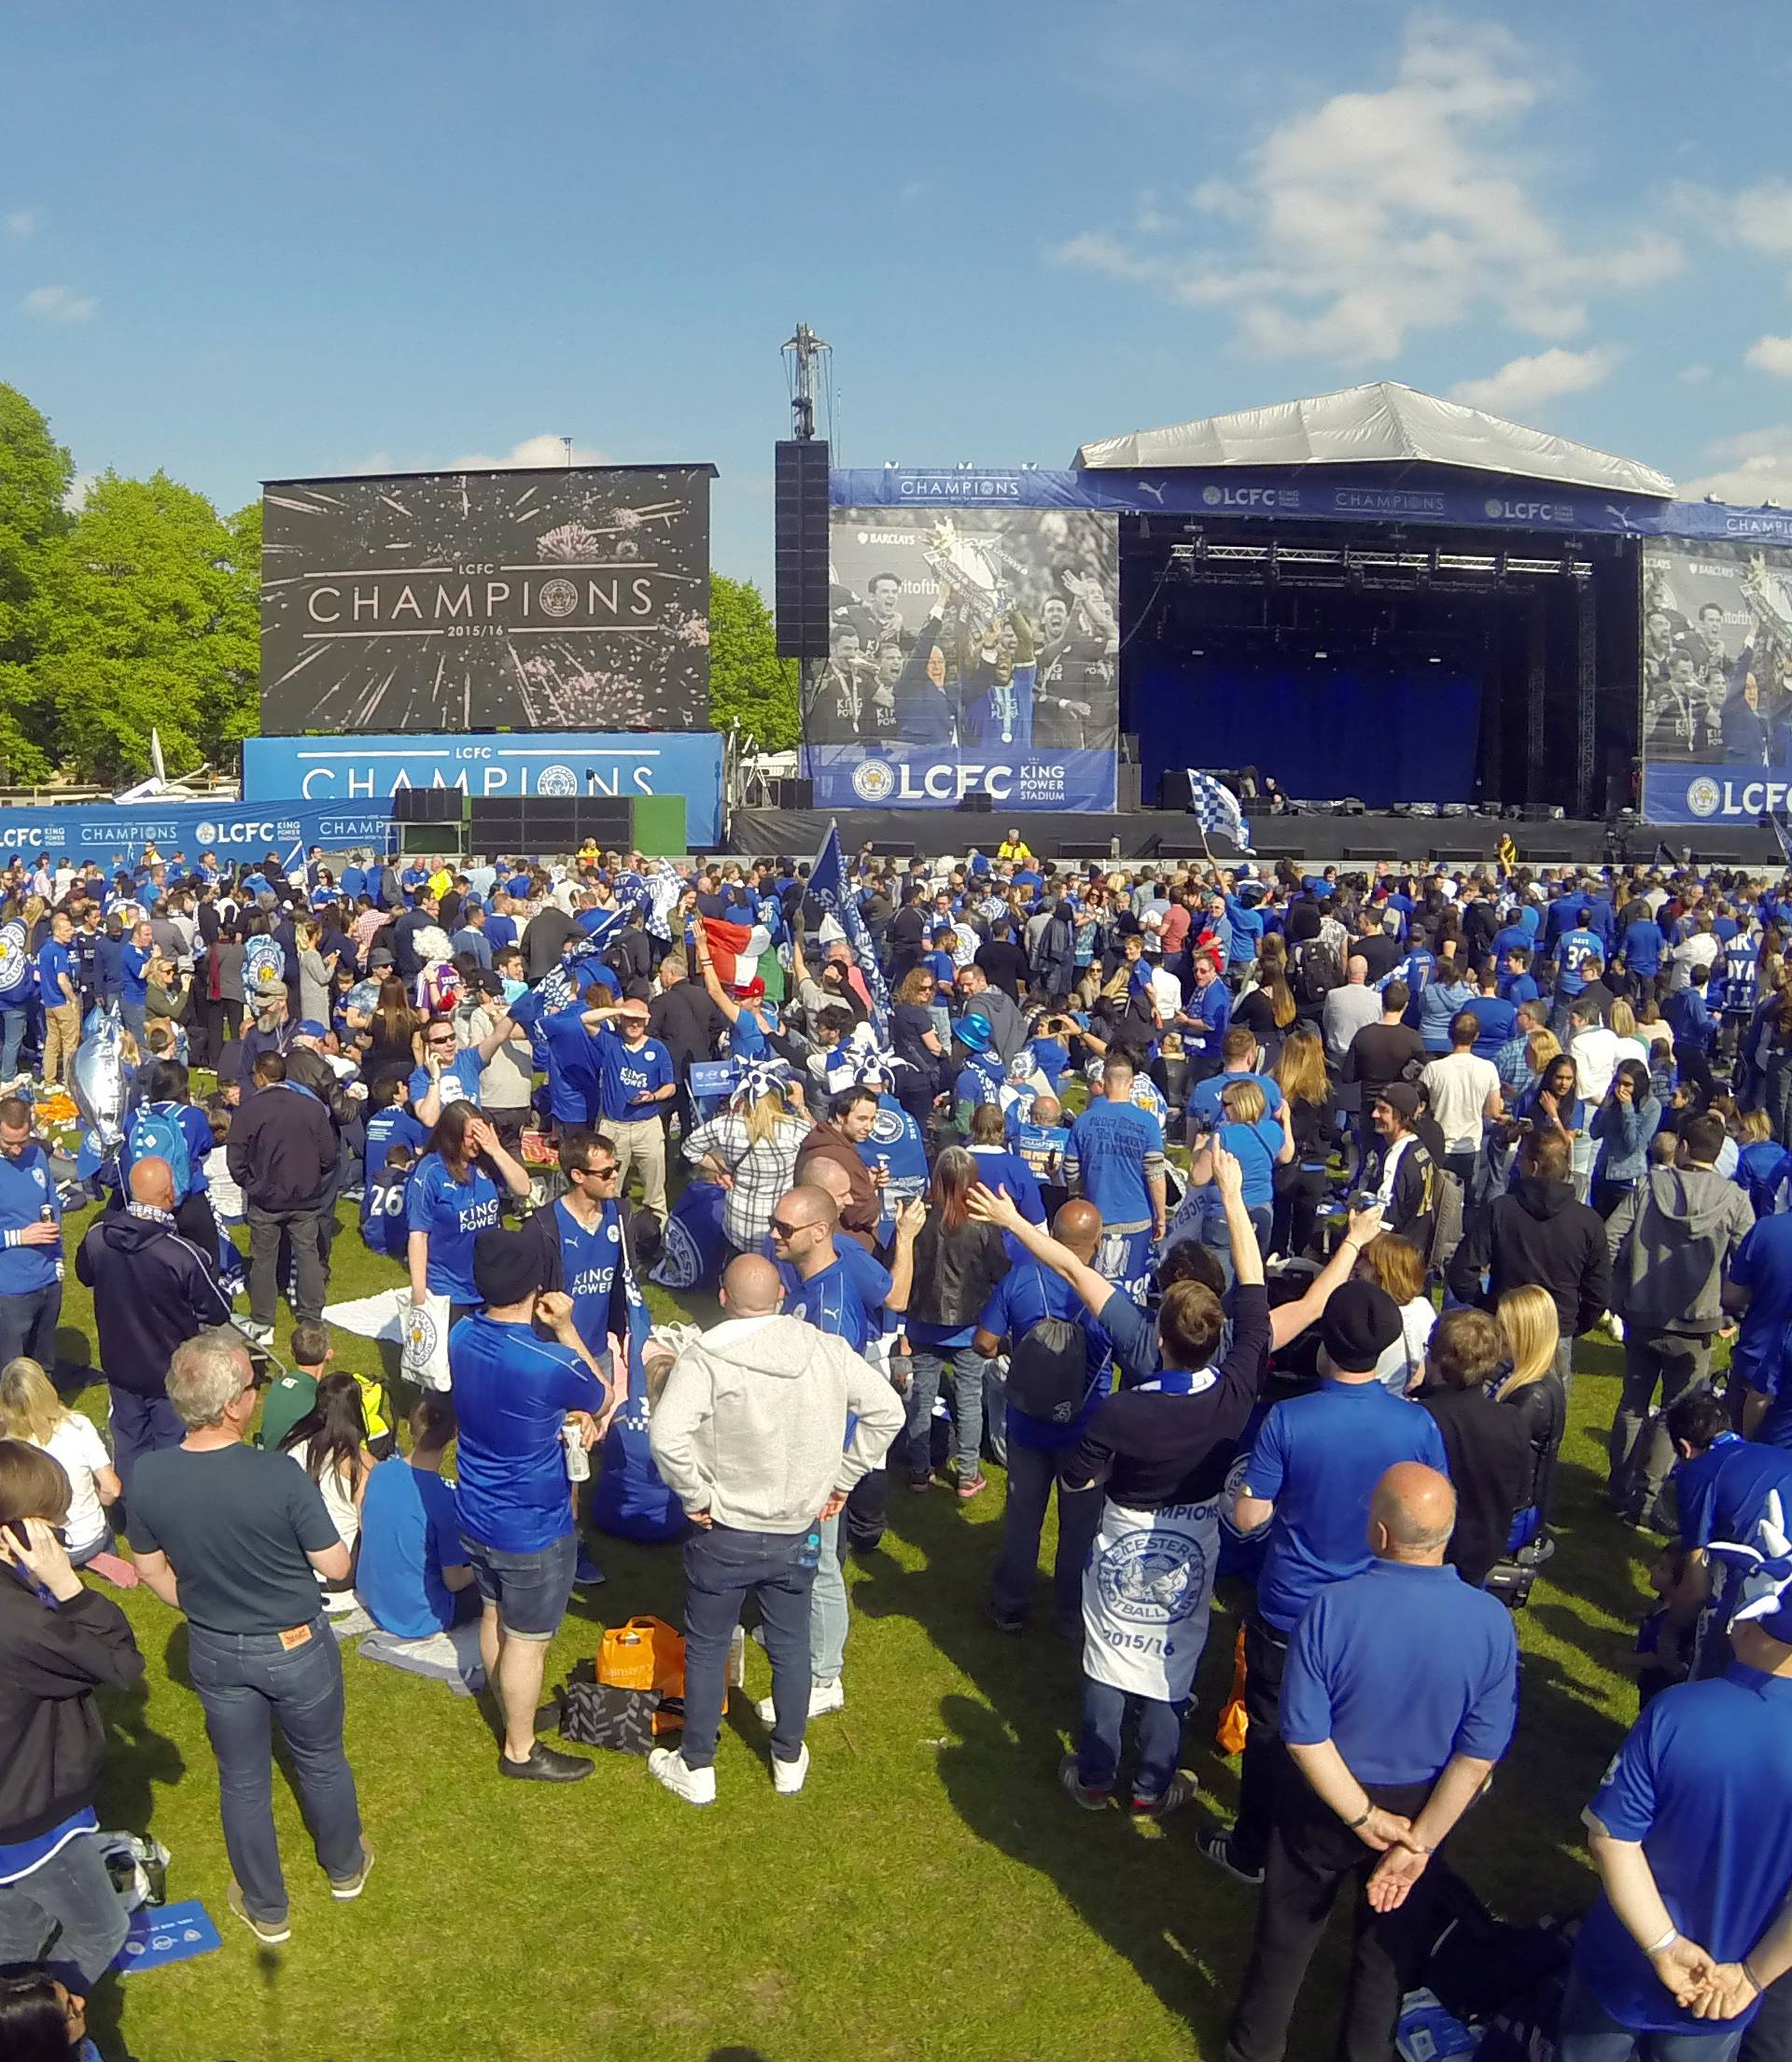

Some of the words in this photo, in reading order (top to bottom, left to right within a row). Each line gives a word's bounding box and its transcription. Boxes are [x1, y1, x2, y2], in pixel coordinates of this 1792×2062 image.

[901, 480, 1019, 496] CHAMPIONS
[1224, 487, 1276, 506] LCFC
[1336, 492, 1444, 511] CHAMPIONS
[1505, 501, 1552, 521] LCFC
[870, 534, 916, 545] BARCLAYS
[458, 563, 495, 575] LCFC
[1699, 564, 1734, 578] BARCLAYS
[308, 578, 653, 624] CHAMPIONS
[448, 624, 504, 638] 2015/16
[455, 747, 492, 760] LCFC
[1020, 765, 1065, 779] KING
[897, 764, 1013, 801] LCFC
[1020, 780, 1065, 791] POWER
[1020, 791, 1066, 801] STADIUM
[81, 826, 177, 841] CHAMPIONS
[217, 822, 274, 843] LCFC
[620, 1066, 648, 1078] KING
[371, 1184, 405, 1217] 26
[459, 1199, 499, 1224] KING
[574, 1267, 614, 1286] KING
